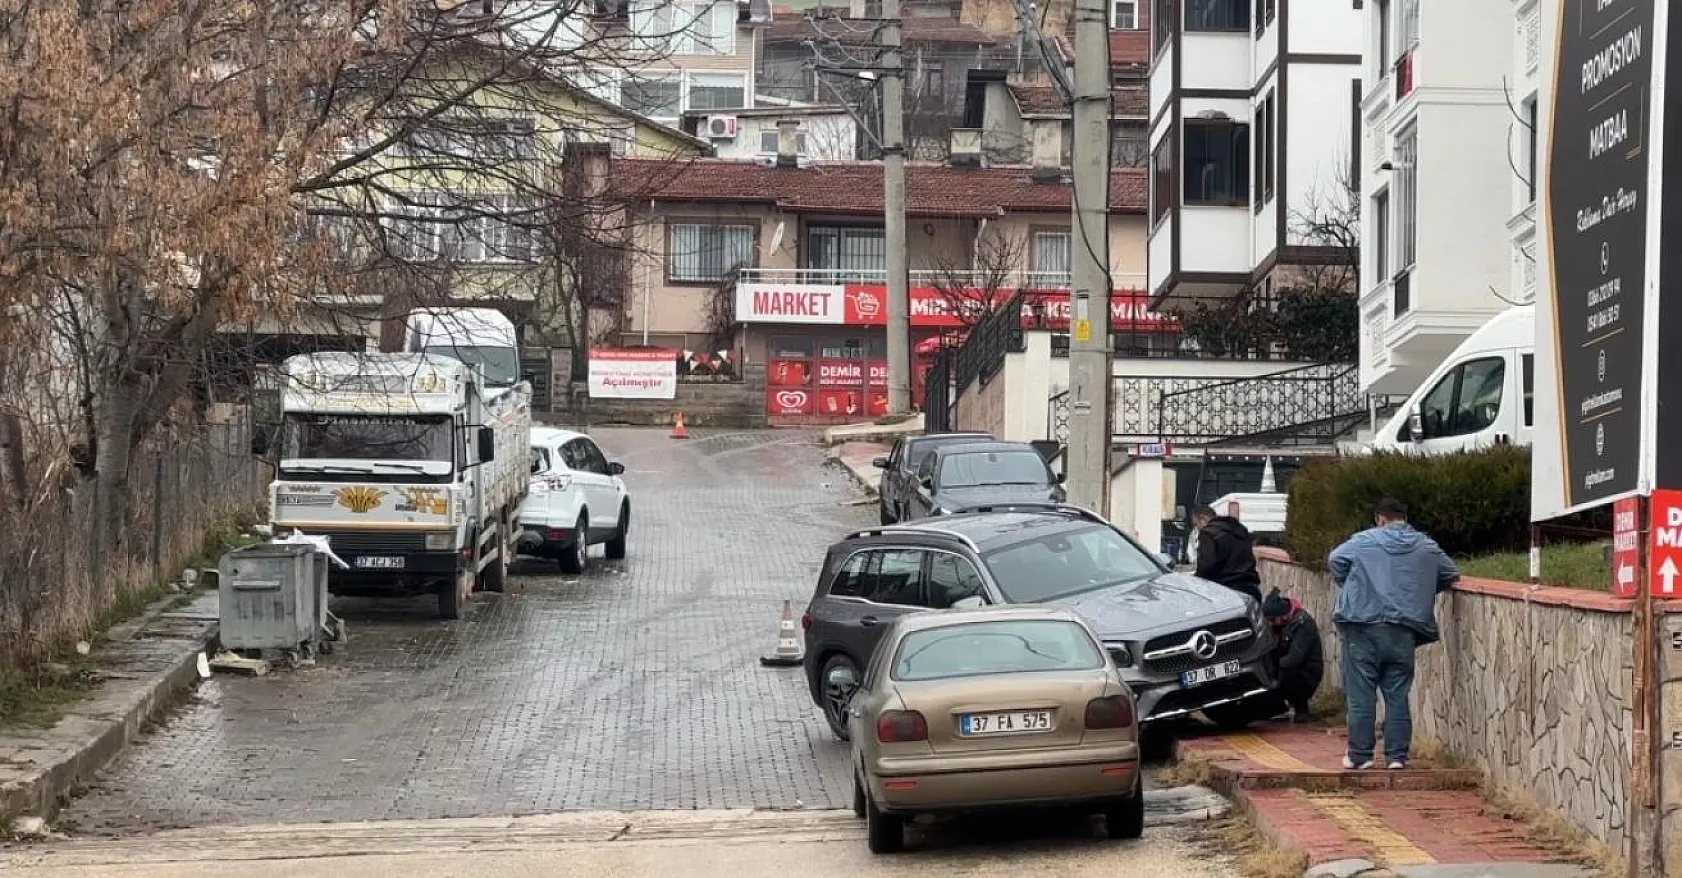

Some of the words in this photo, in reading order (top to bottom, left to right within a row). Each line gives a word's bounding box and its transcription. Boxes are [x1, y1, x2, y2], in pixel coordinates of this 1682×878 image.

[1581, 25, 1642, 95] PROMOSYON
[1590, 108, 1628, 160] MATBAA
[753, 291, 832, 317] MARKET
[910, 297, 947, 316] MİR
[820, 363, 861, 377] DEMİR
[973, 717, 988, 731] 37
[998, 715, 1013, 729] FA
[1024, 712, 1047, 728] 575
